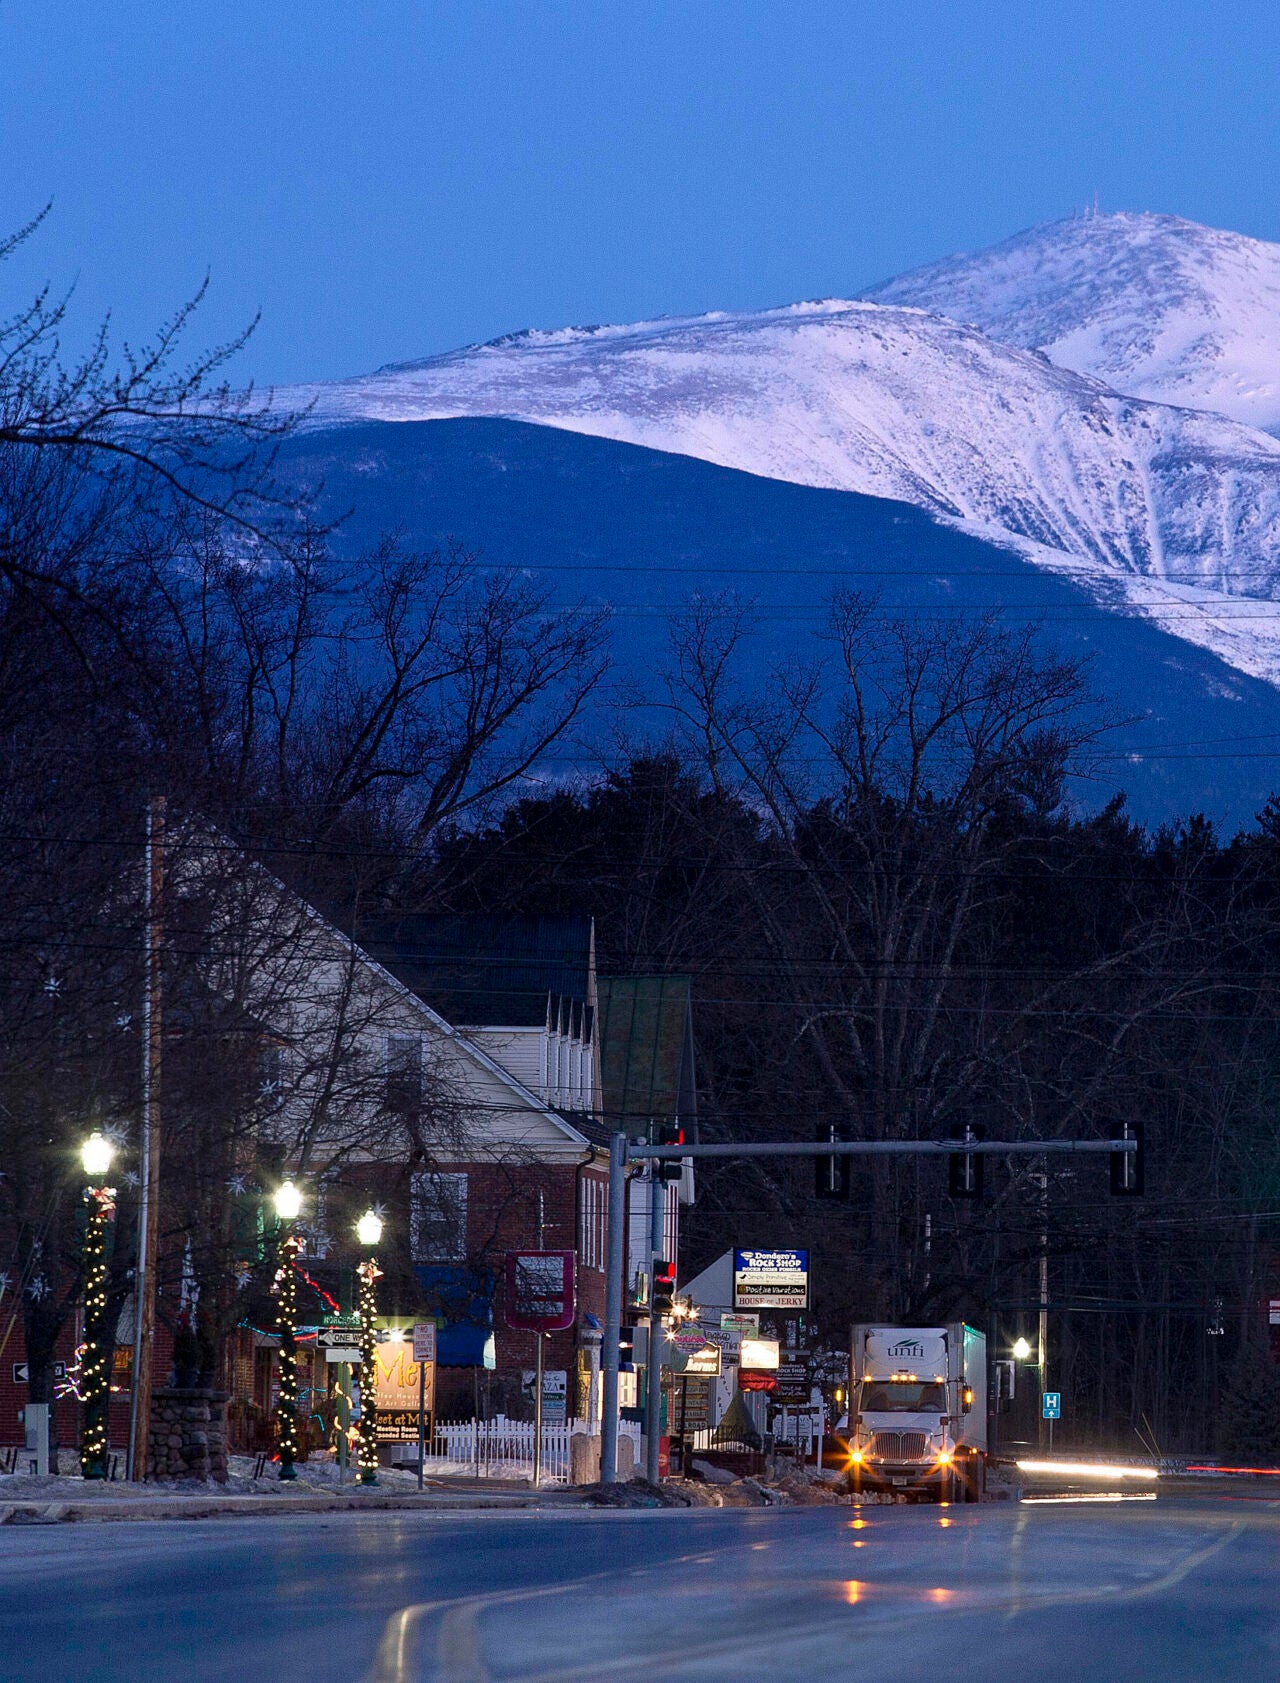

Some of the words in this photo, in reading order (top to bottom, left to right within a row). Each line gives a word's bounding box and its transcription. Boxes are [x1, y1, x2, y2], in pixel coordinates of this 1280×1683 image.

[749, 1259, 775, 1267] ROCK
[776, 1259, 802, 1267] SHOP
[739, 1297, 765, 1305] HOUSE
[775, 1297, 804, 1305] JERKY
[334, 1333, 353, 1342] ONE
[887, 1343, 925, 1357] unfi
[1046, 1395, 1057, 1408] H
[395, 1413, 406, 1425] at
[406, 1412, 429, 1426] Mt
